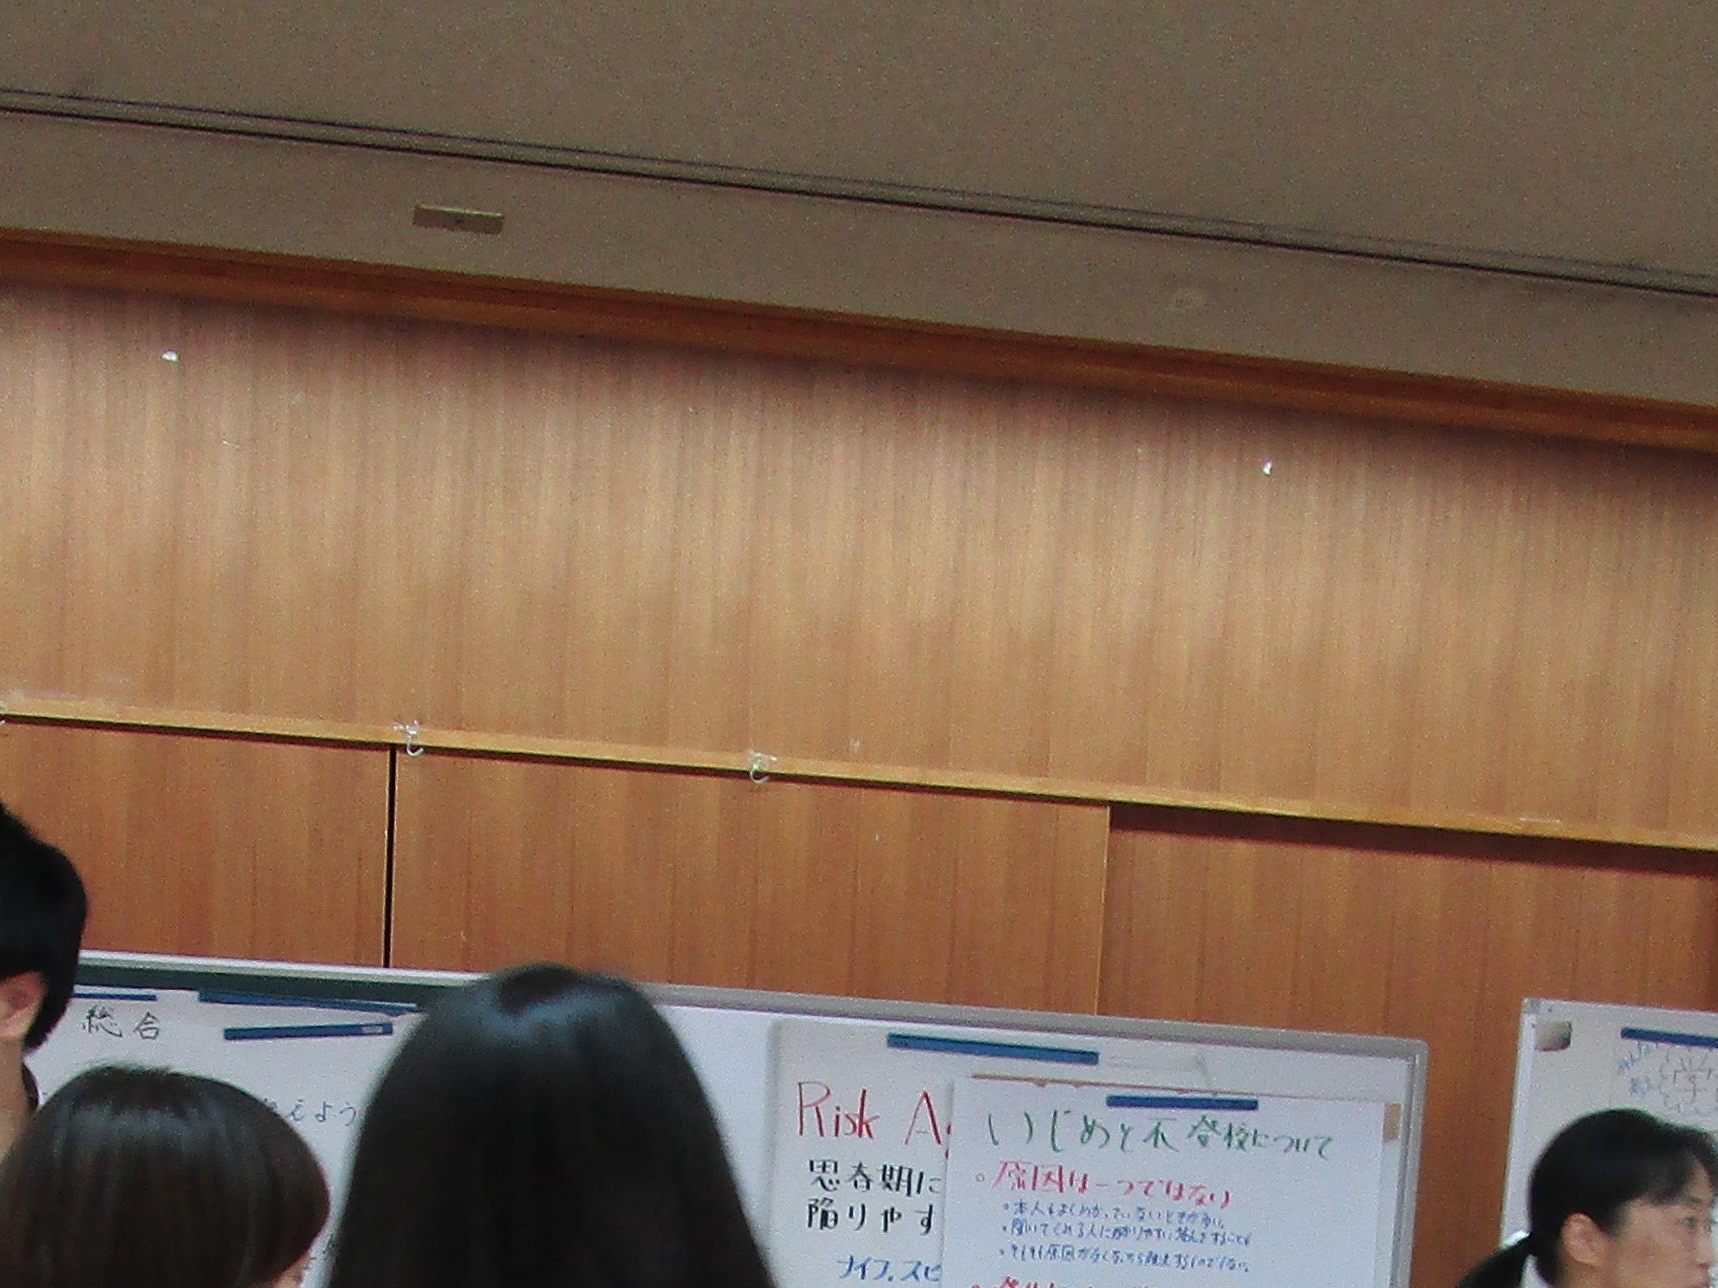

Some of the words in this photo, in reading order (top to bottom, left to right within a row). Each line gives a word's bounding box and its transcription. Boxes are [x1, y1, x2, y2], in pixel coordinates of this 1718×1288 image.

[84, 1006, 161, 1041] 総合
[797, 1080, 880, 1140] Risk
[988, 1109, 1334, 1161] いじめと不登校について
[808, 1158, 942, 1197] 思春期に
[991, 1160, 1233, 1209] 原因は一つではない
[807, 1197, 936, 1236] 陥りやす
